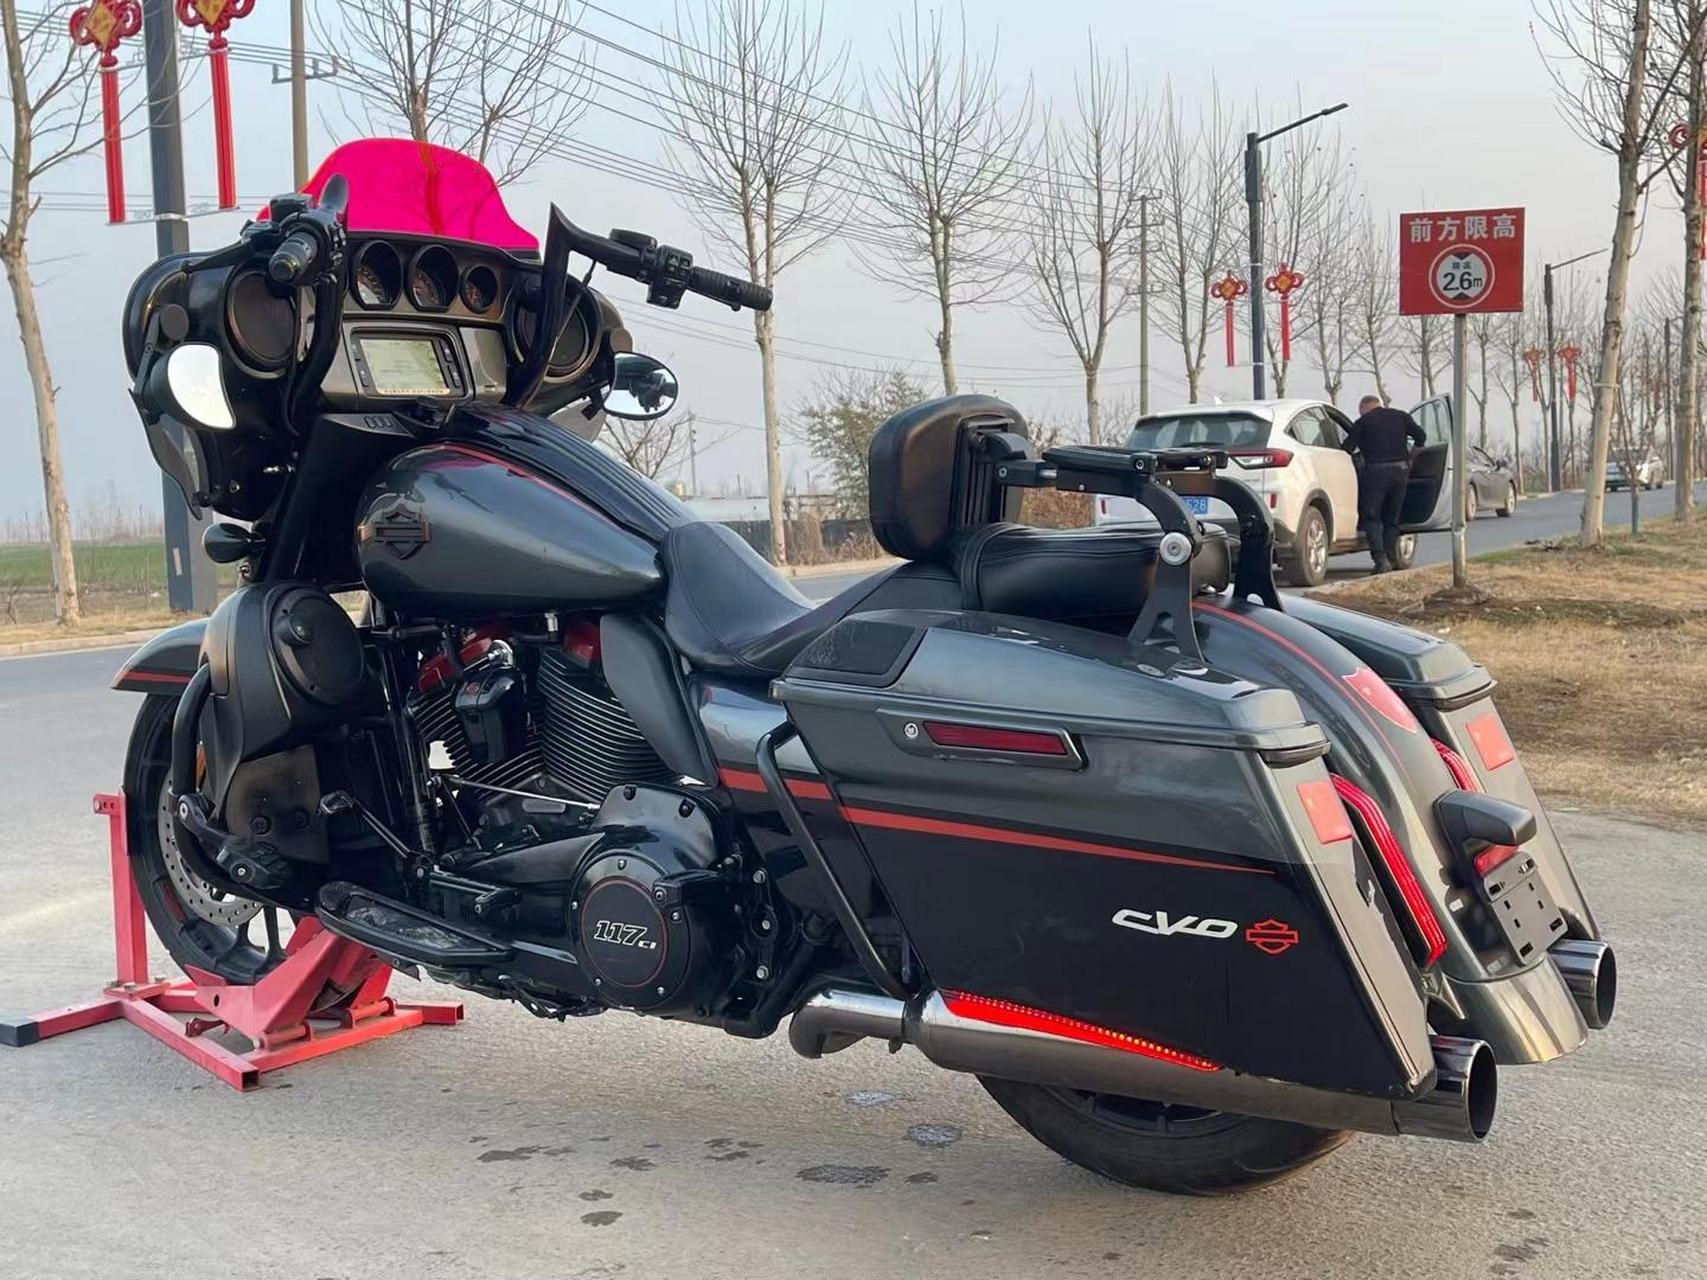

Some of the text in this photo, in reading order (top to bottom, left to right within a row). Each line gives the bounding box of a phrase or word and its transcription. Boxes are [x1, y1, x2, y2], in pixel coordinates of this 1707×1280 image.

[1409, 214, 1517, 243] 前方限高
[1442, 271, 1483, 291] 2.6m
[1111, 908, 1239, 939] CVO
